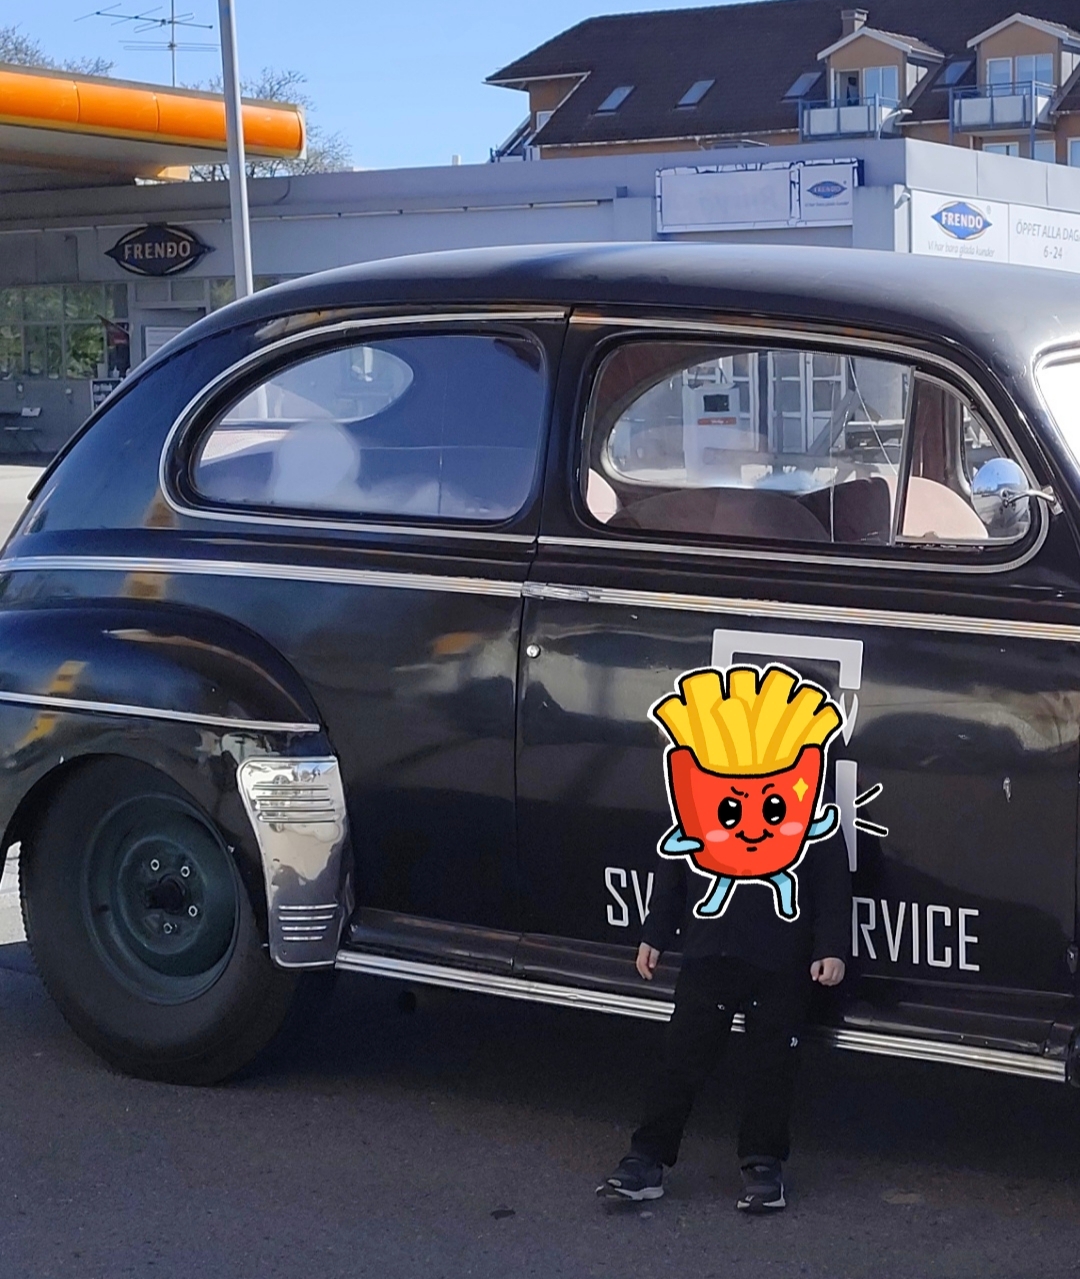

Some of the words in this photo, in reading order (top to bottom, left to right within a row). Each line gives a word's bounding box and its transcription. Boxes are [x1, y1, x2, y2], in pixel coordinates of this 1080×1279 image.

[942, 211, 983, 229] FRENDO
[1016, 219, 1041, 236] ÖPPET
[1042, 225, 1062, 239] ALLA
[124, 241, 191, 259] FRENDO
[605, 867, 654, 926] SV
[852, 896, 980, 971] RVICE
